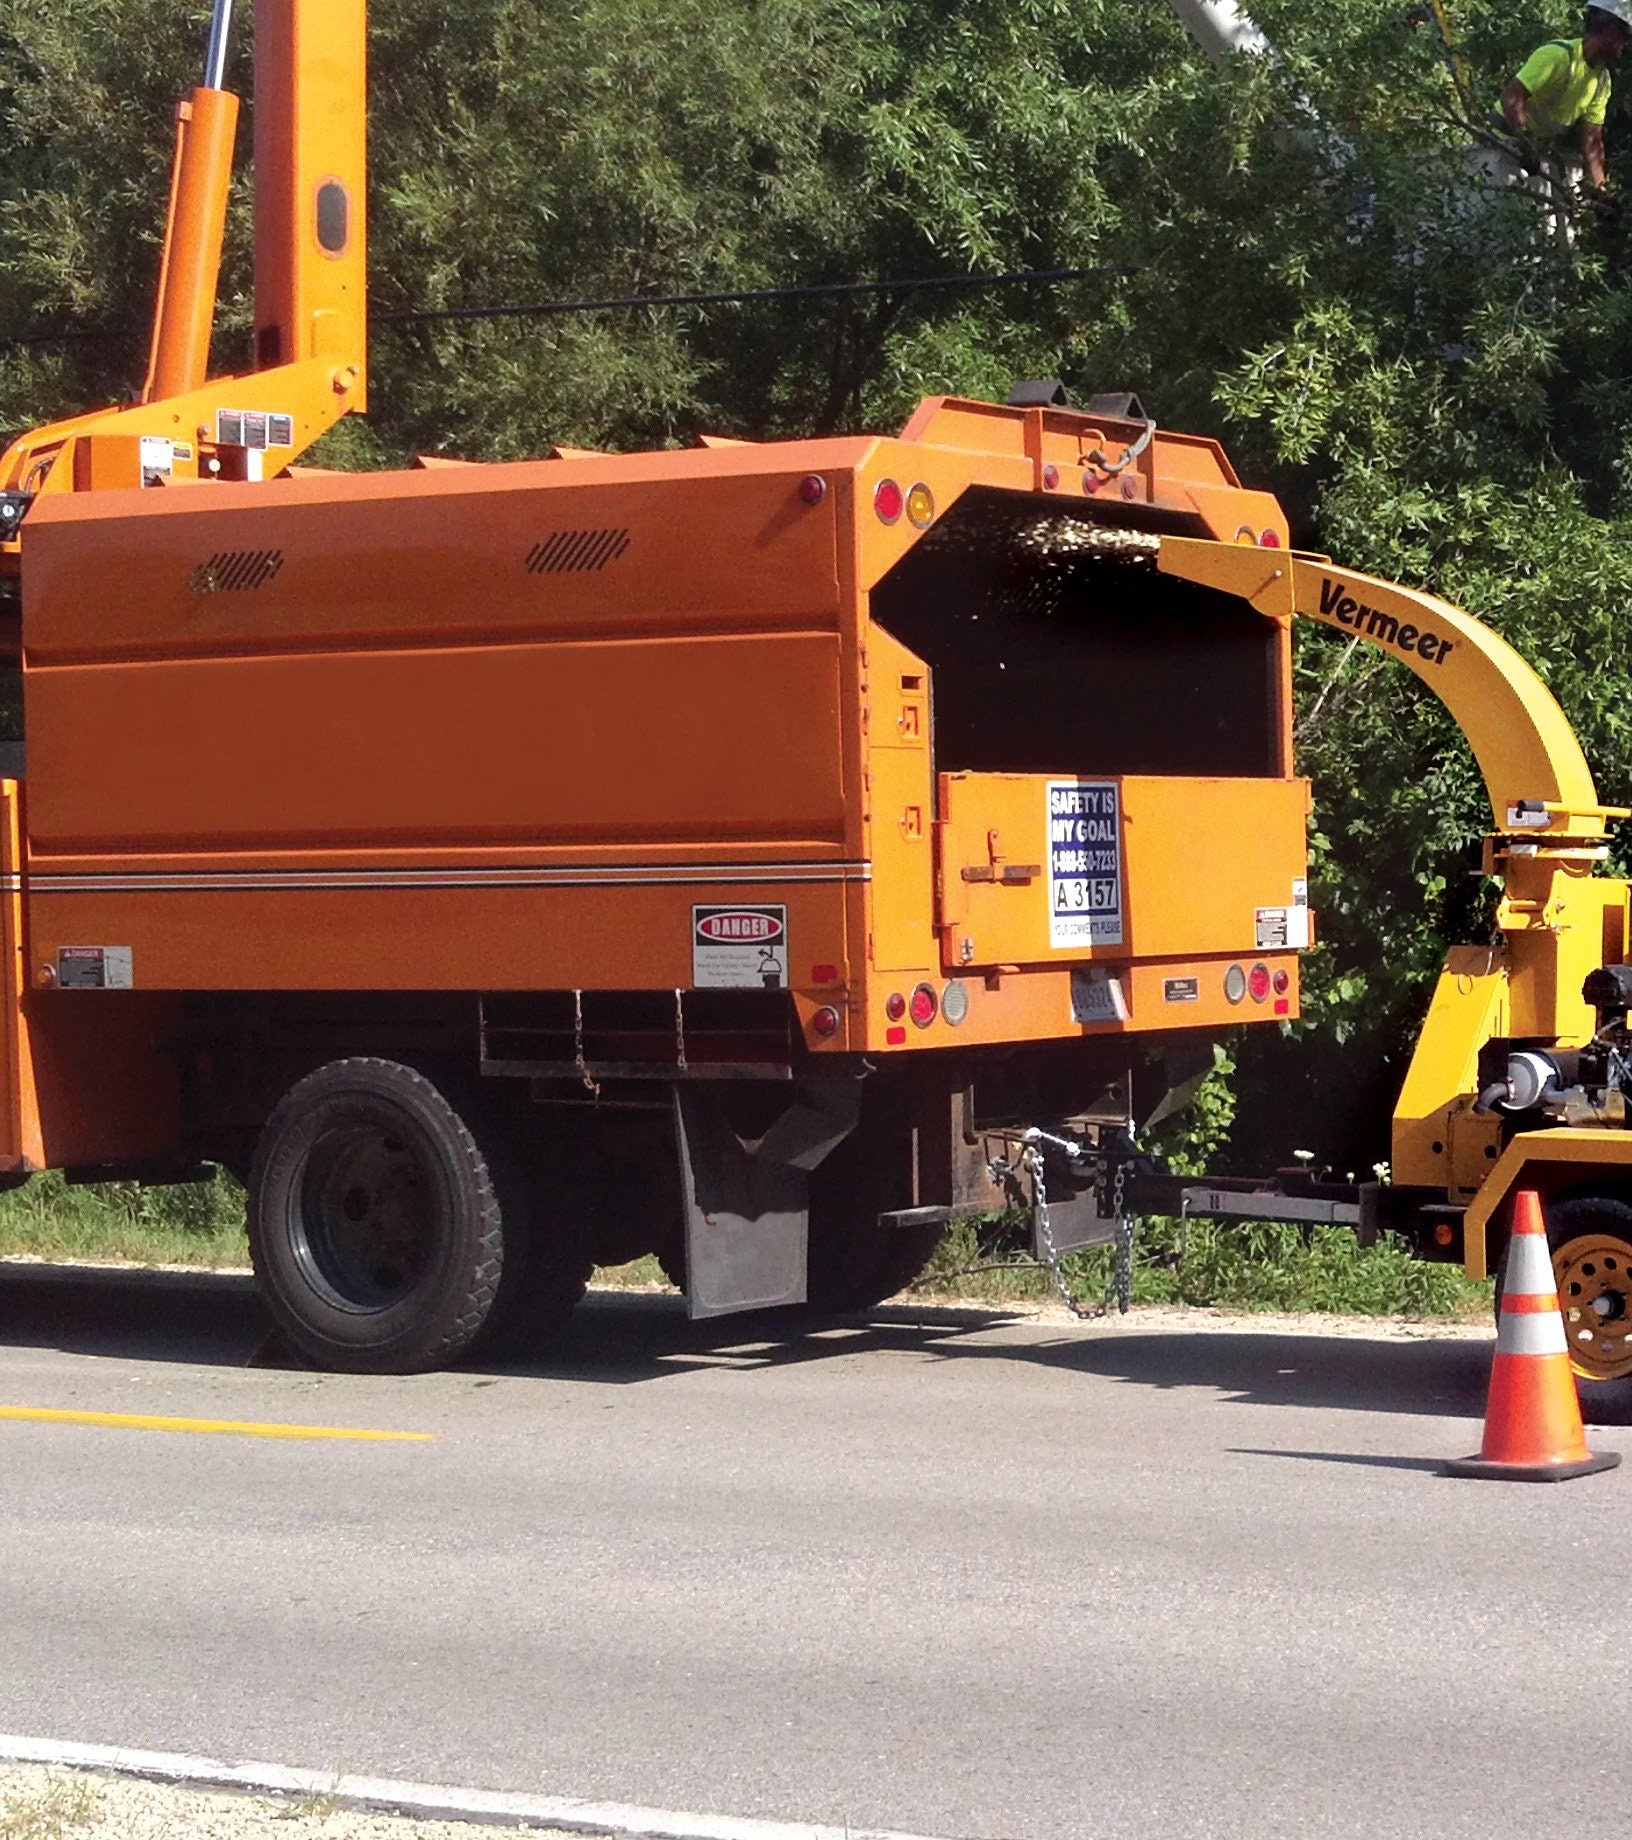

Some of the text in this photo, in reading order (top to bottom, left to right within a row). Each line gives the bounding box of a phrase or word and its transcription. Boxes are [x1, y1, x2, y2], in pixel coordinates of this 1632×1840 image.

[1319, 578, 1453, 665] Vermeer
[1051, 791, 1115, 814] SAFETY IS
[1051, 819, 1115, 842] MY GOAL
[1057, 880, 1114, 908] A 3157
[711, 918, 769, 935] DANGER
